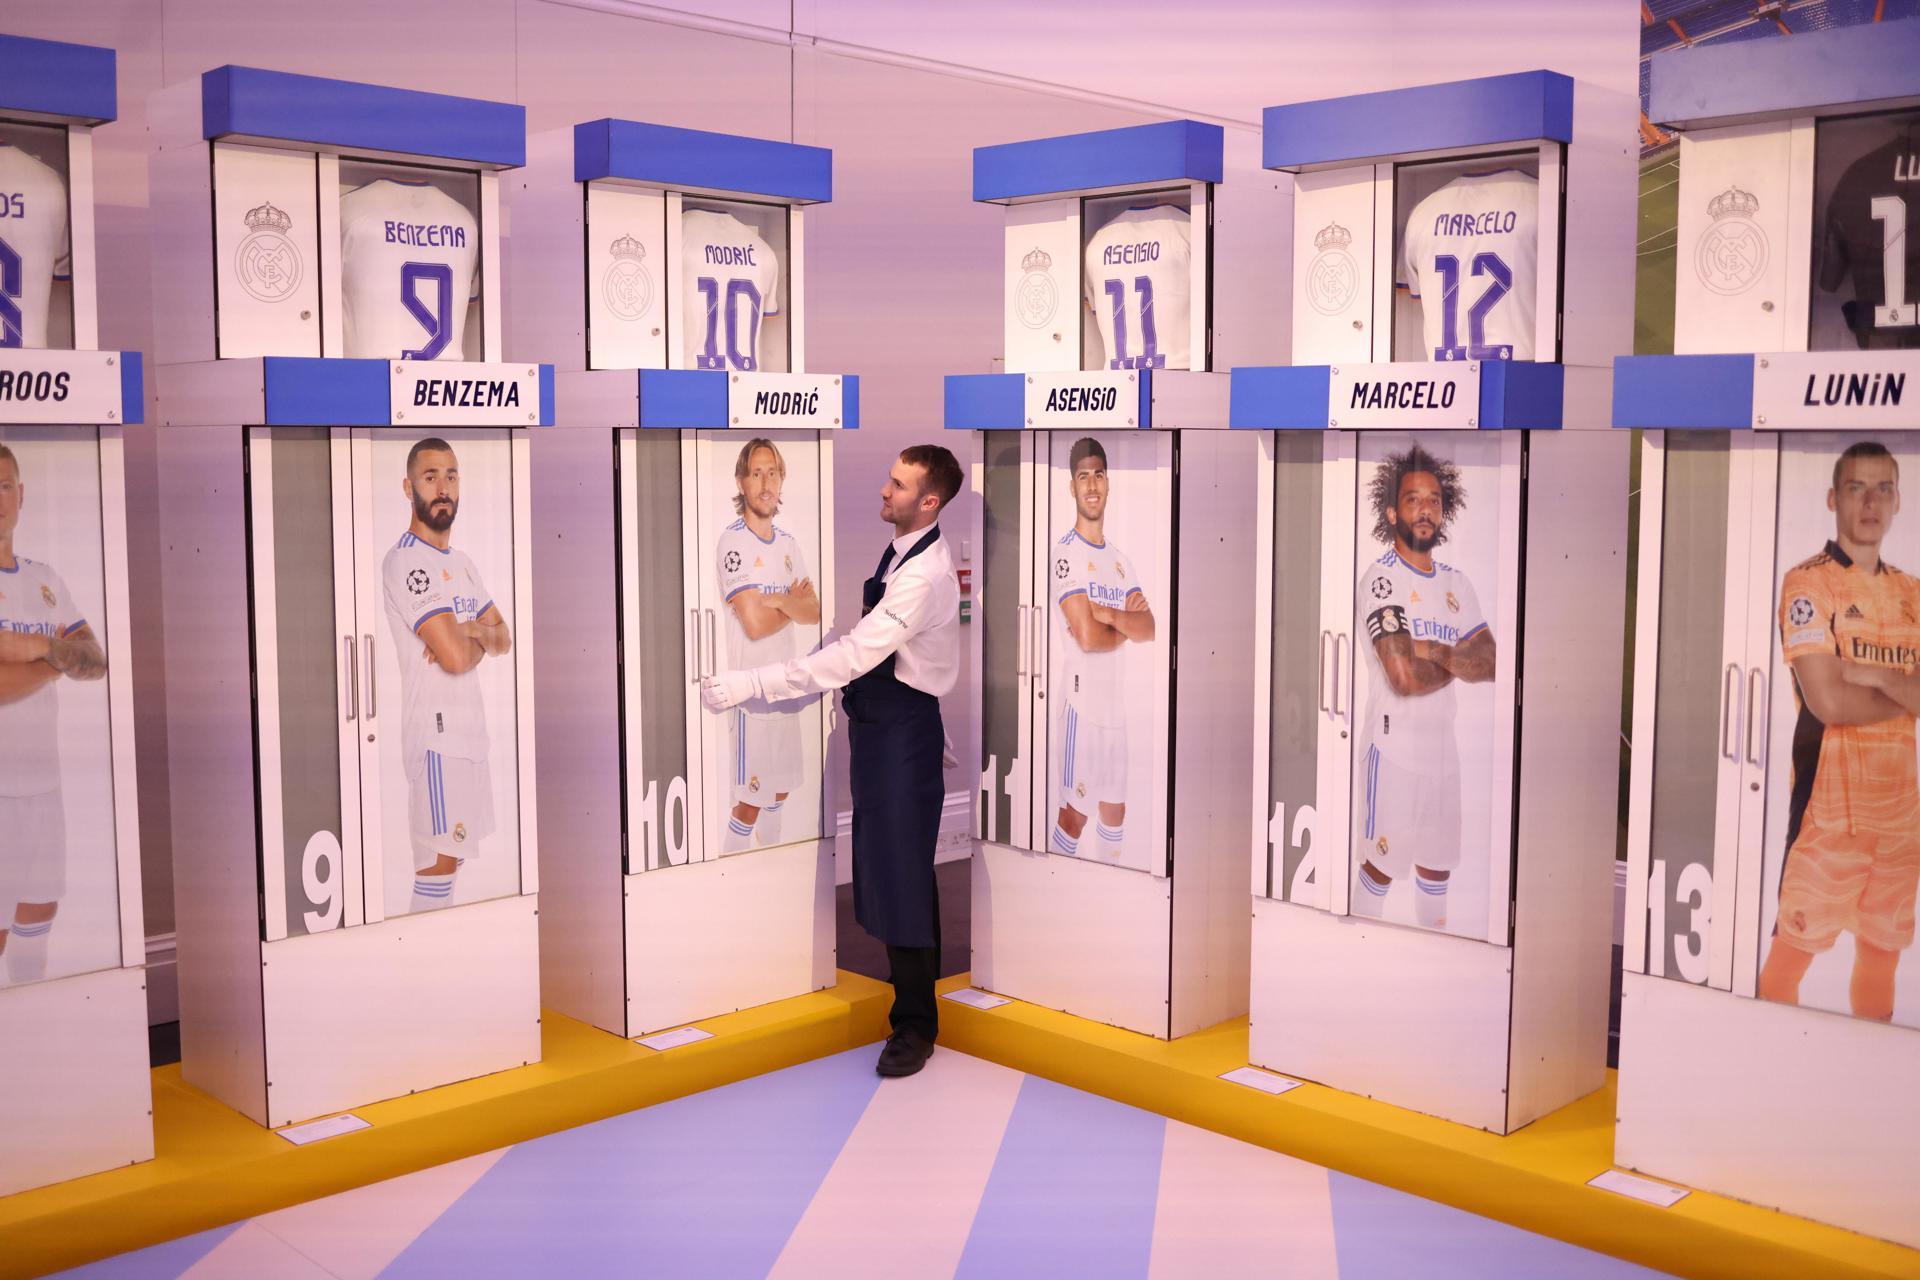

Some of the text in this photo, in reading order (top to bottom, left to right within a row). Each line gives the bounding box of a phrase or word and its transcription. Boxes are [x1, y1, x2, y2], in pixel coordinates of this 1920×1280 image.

[384, 220, 466, 249] BENZEMA
[705, 244, 757, 267] MODRIĆ
[1103, 241, 1160, 265] ASENSIO
[1434, 210, 1517, 237] MARCELO
[1871, 195, 1920, 328] 1
[401, 261, 453, 361] 9
[697, 276, 762, 371] 10
[1104, 275, 1166, 370] 11
[1434, 251, 1514, 362] 12
[413, 379, 520, 407] BENZEMA
[1350, 380, 1456, 409] MARCELO
[641, 775, 688, 872] 10
[1268, 801, 1318, 904] 12
[302, 829, 344, 935] 9
[1647, 859, 1713, 984] 13
